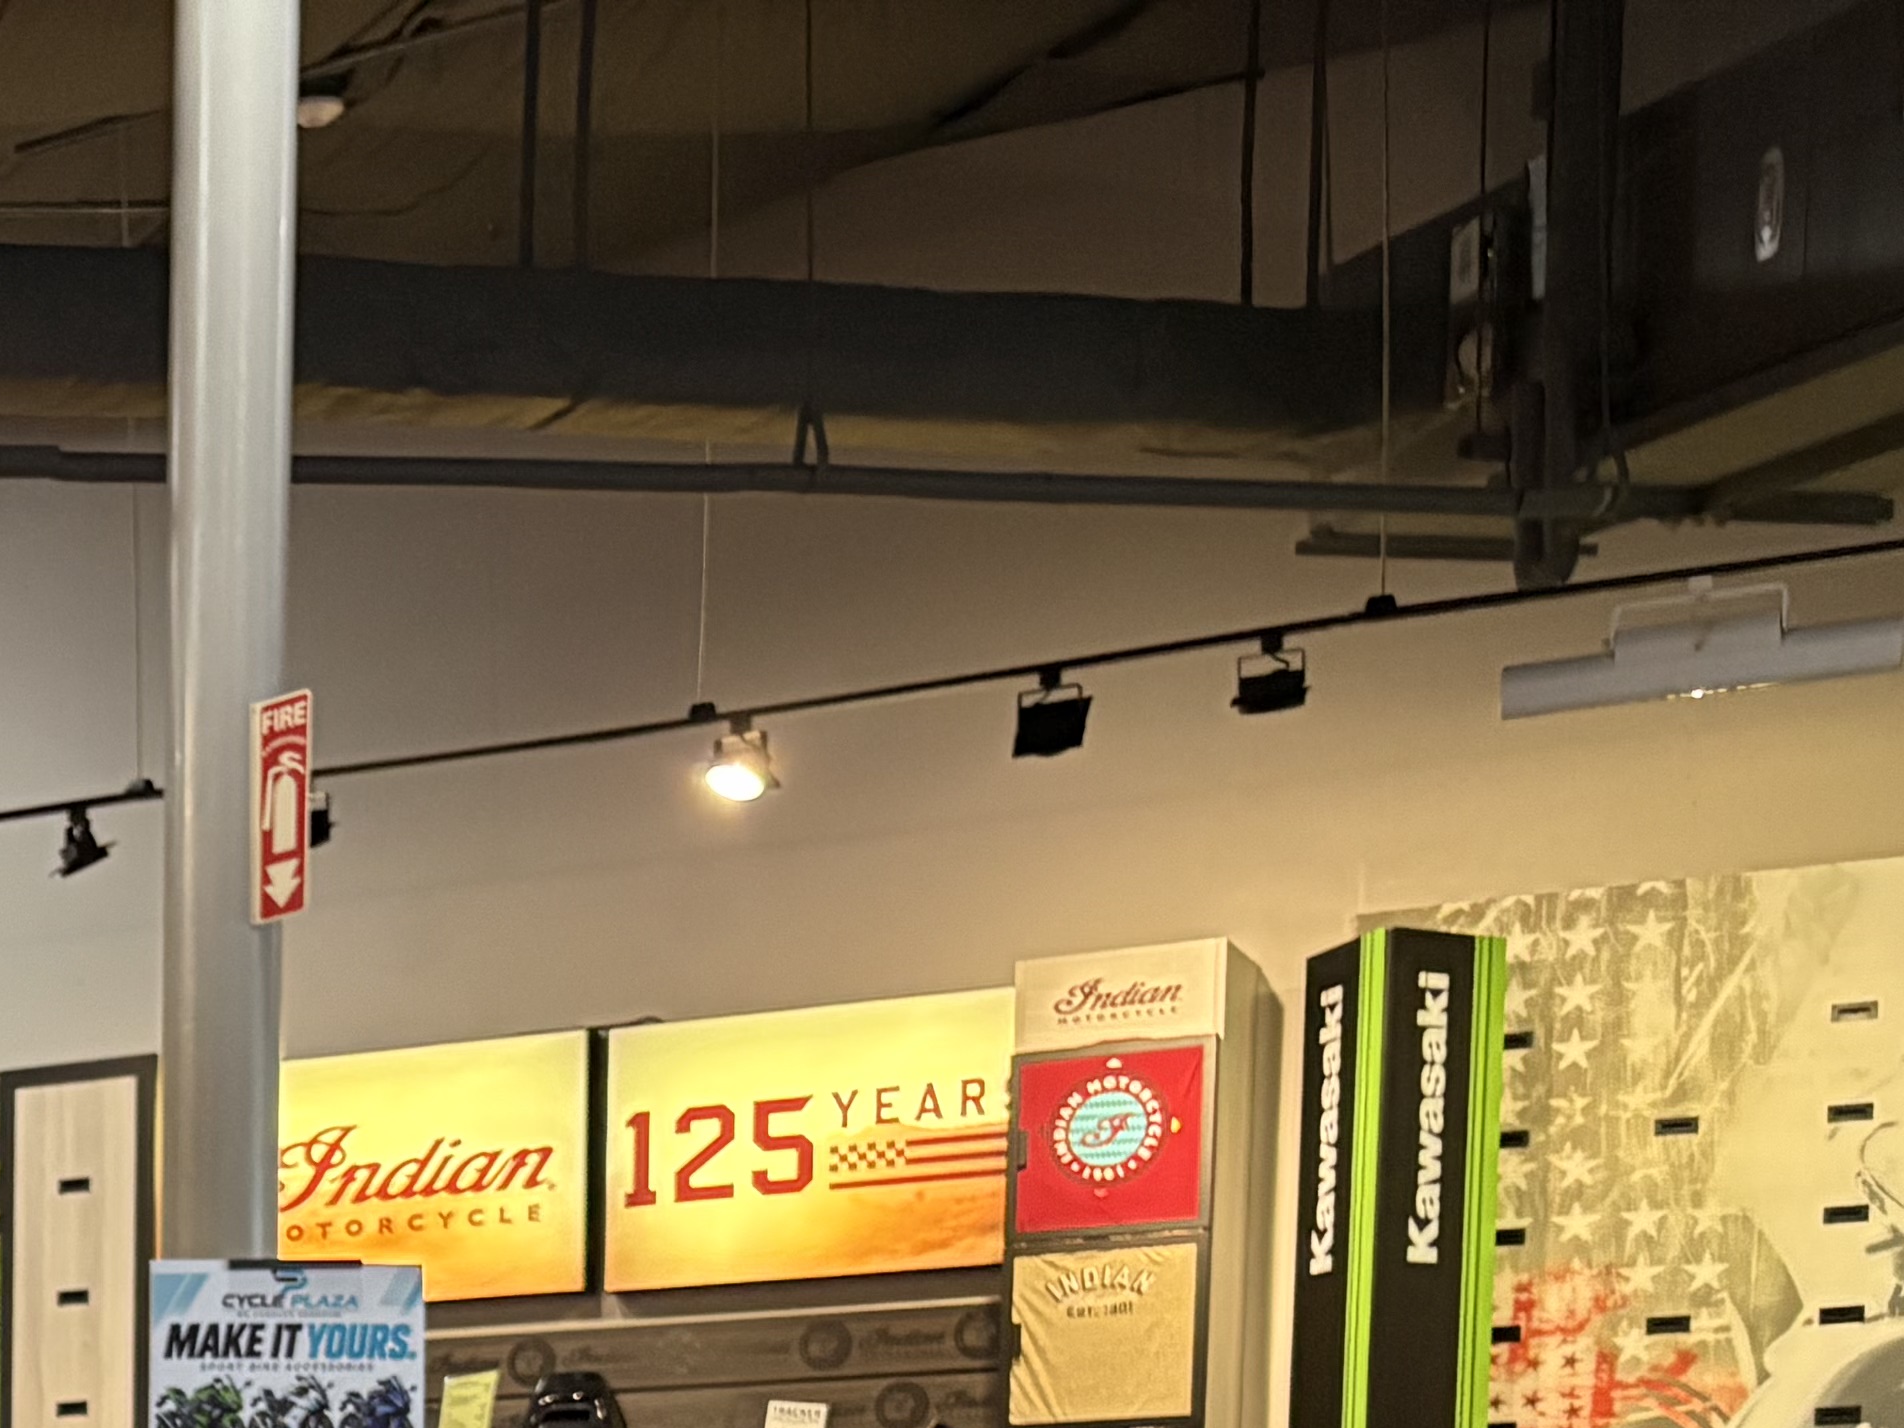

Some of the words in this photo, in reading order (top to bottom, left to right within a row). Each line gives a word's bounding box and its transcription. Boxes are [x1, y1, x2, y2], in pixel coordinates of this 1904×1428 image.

[261, 700, 307, 735] FIRE
[1053, 977, 1184, 1016] Indian
[1057, 1006, 1178, 1025] MOTORCYCLE
[1086, 1075, 1163, 1161] MOTORCYCLE
[1310, 984, 1343, 1275] Kawasaki
[1408, 971, 1450, 1264] Kawasaki
[625, 1096, 813, 1207] 125
[831, 1078, 987, 1129] YEAR
[278, 1125, 557, 1212] Indian
[285, 1202, 544, 1243] OTORCYCLE
[221, 1293, 284, 1310] CYCLE
[290, 1294, 359, 1311] PLAZA
[1046, 1263, 1156, 1303] INDIAN
[163, 1322, 264, 1361] MAKE
[270, 1322, 303, 1360] IT
[307, 1322, 418, 1361] YOURS.
